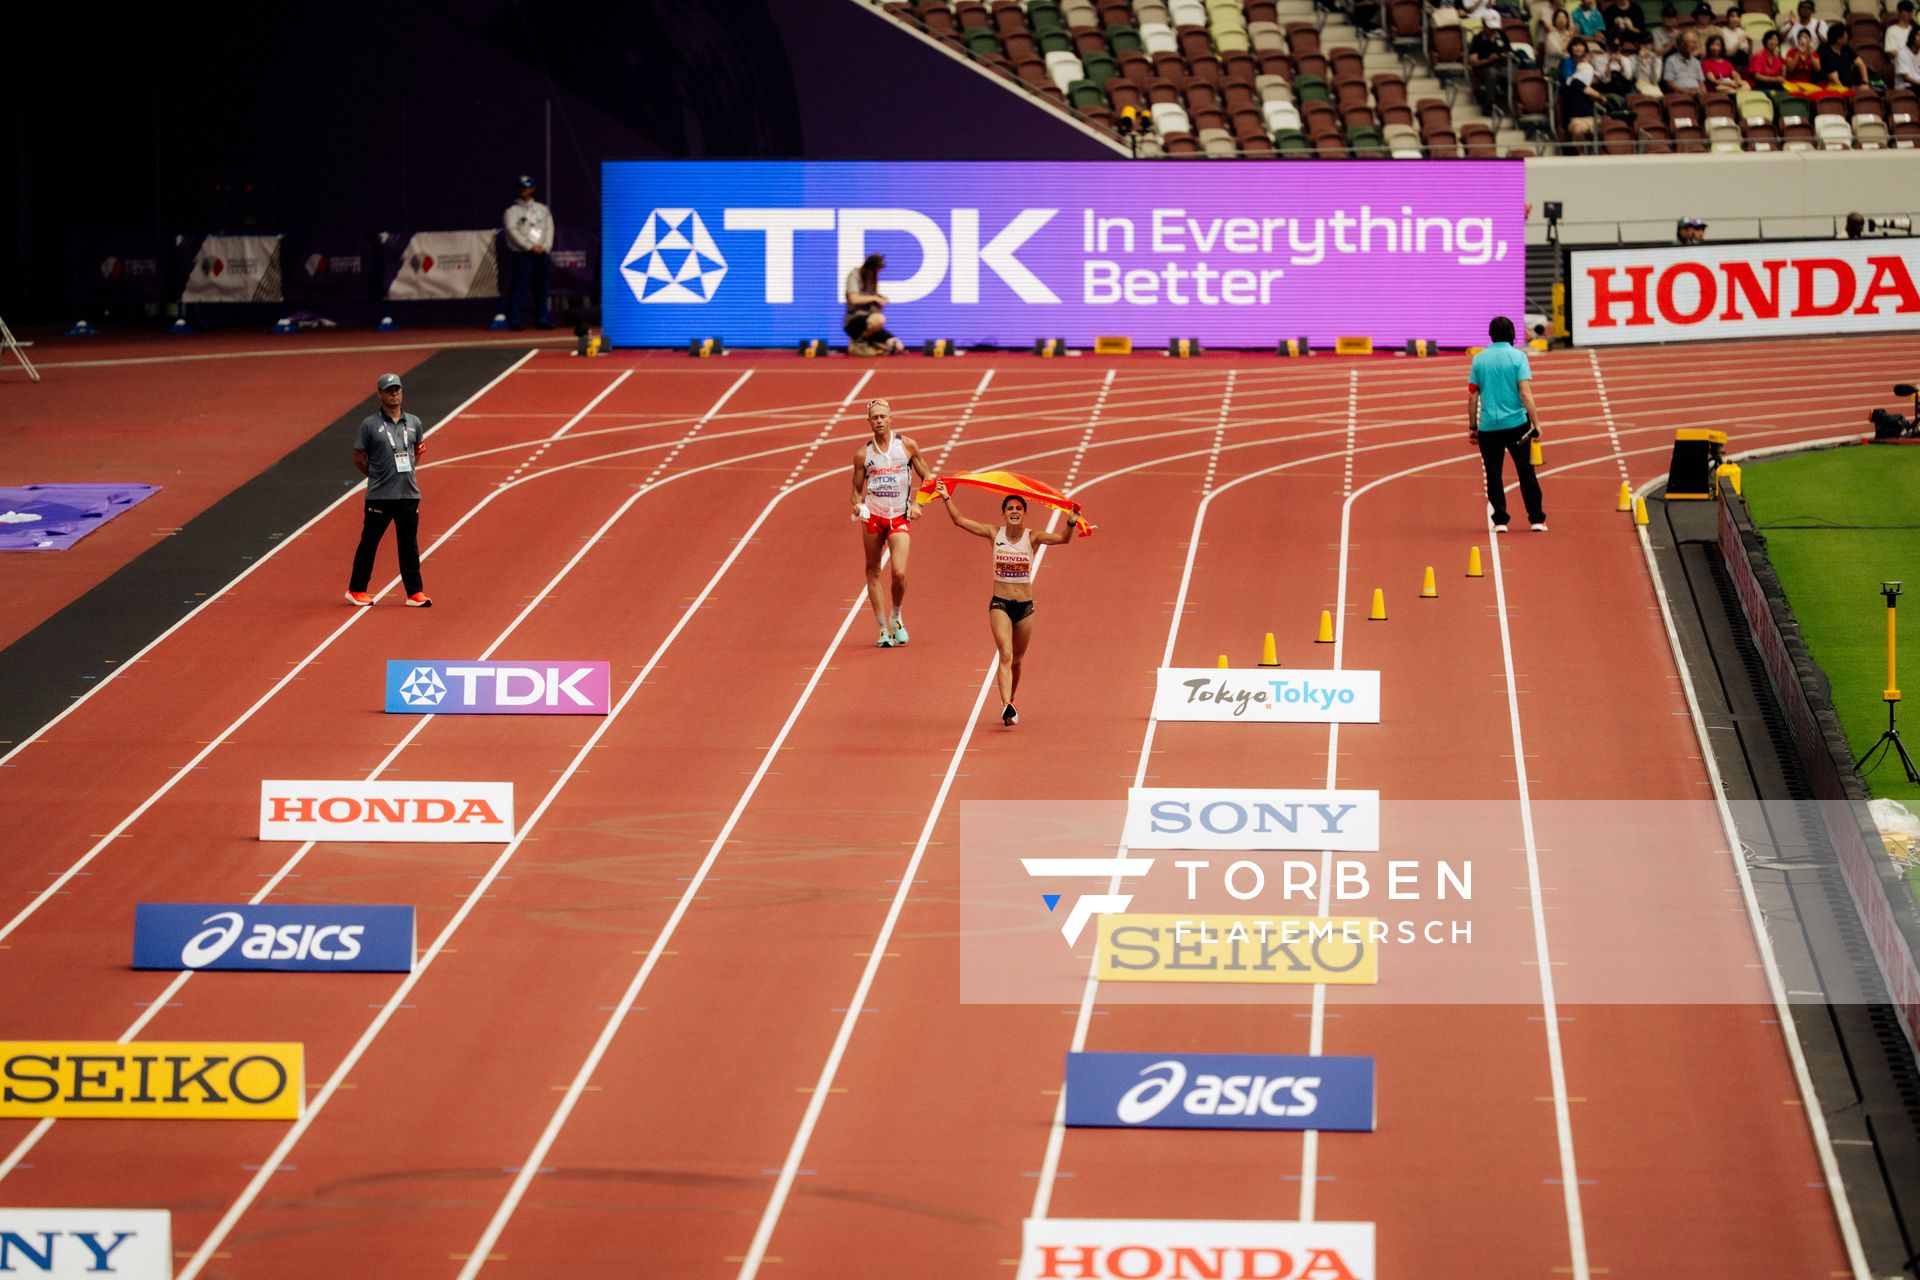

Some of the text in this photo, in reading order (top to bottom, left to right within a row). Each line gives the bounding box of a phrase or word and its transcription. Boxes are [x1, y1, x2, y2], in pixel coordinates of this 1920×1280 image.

[1083, 205, 1508, 265] In Everything,
[724, 208, 1063, 304] TDK
[1083, 260, 1284, 304] Better
[1587, 256, 1920, 328] HONDA
[446, 668, 595, 706] TDK
[1182, 678, 1355, 717] Tokyo Tokyo
[268, 797, 503, 824] HONDA
[1150, 801, 1357, 834] SONY
[242, 924, 365, 960] asics
[1110, 926, 1364, 973] SEIKO
[3, 1055, 287, 1104] SEIKO
[1184, 1075, 1321, 1116] asics
[1036, 1245, 1361, 1280] HONDA
